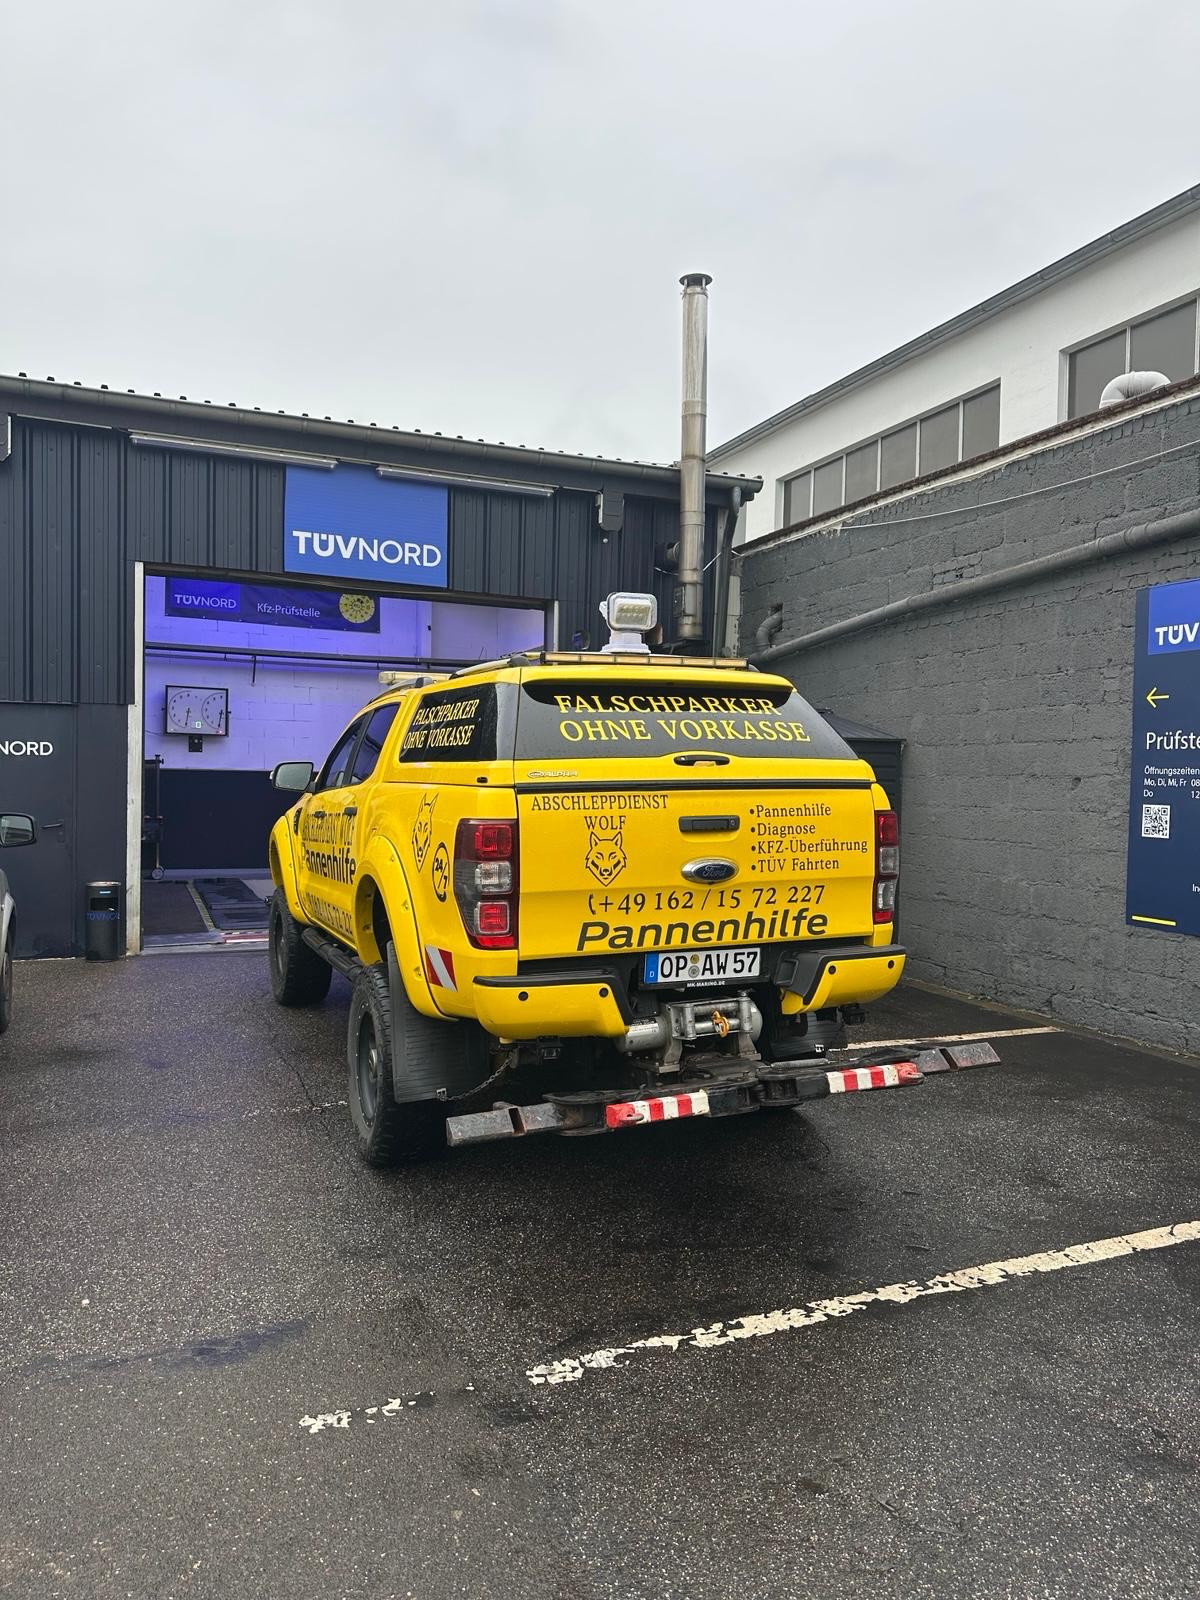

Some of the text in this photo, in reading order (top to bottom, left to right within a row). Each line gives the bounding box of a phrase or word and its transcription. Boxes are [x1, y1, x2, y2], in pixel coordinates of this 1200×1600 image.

[292, 530, 442, 567] TÜVNORD
[257, 603, 321, 618] Kfz-Prüfstelle
[1155, 622, 1200, 646] TÜV
[412, 699, 479, 726] FALSCHPARKER
[554, 695, 782, 716] FALSCHPARKER
[403, 725, 475, 749] OHNE VORKASSE
[559, 719, 811, 743] OHNE VORKASSE
[1180, 779, 1187, 787] Fr
[531, 794, 668, 811] ABSCHLEPPDIENST
[1144, 789, 1154, 798] Do
[756, 803, 832, 818] Pannenhilfe
[584, 815, 627, 830] WOLF
[757, 822, 816, 838] Diagnose
[757, 836, 868, 855] KFZ-Überführung
[757, 855, 839, 873] TÜV Fahrten
[599, 893, 646, 915] +49
[655, 889, 694, 910] 162
[718, 889, 741, 908] 15
[752, 887, 777, 908] 72
[788, 885, 825, 904] 227
[576, 907, 829, 952] Pannenhilfe
[660, 955, 688, 978] OP
